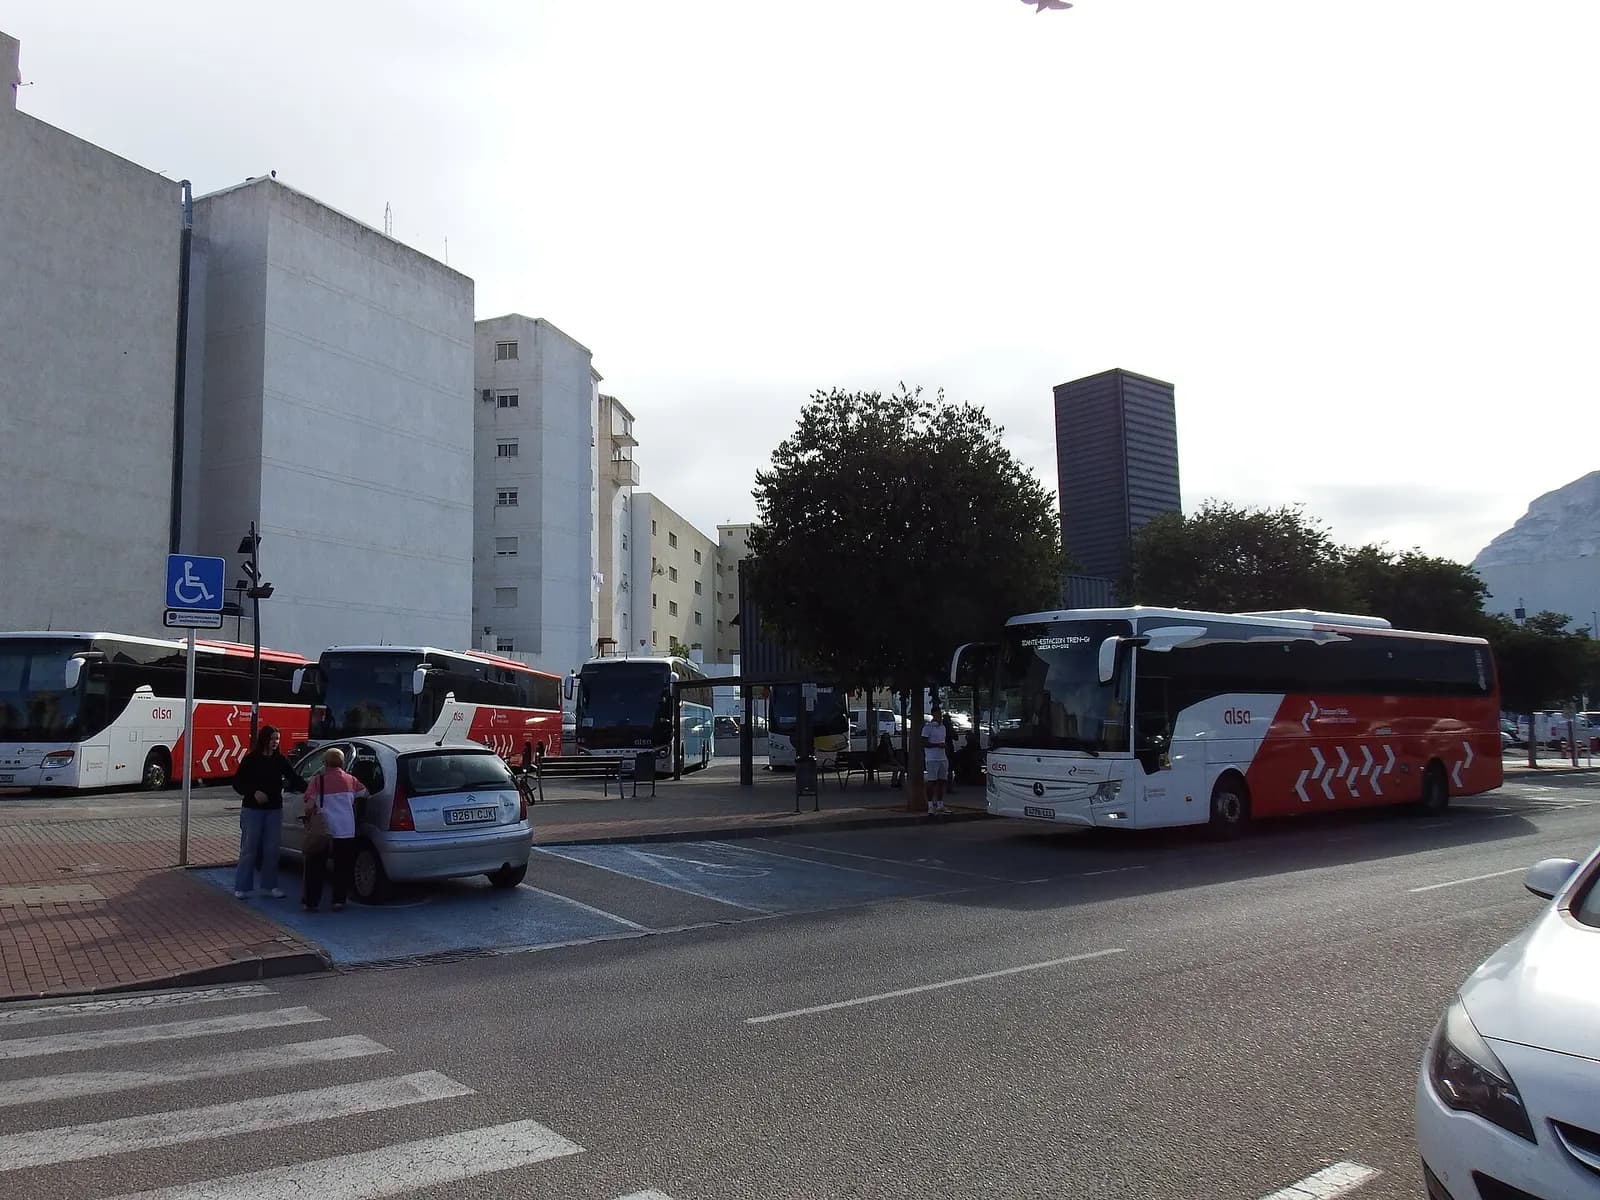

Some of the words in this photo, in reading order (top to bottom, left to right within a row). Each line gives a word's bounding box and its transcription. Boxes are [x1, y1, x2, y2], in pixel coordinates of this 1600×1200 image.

[152, 707, 172, 719] alsa
[453, 710, 464, 721] alsa
[1224, 707, 1251, 724] alsa
[991, 762, 1007, 771] alsa
